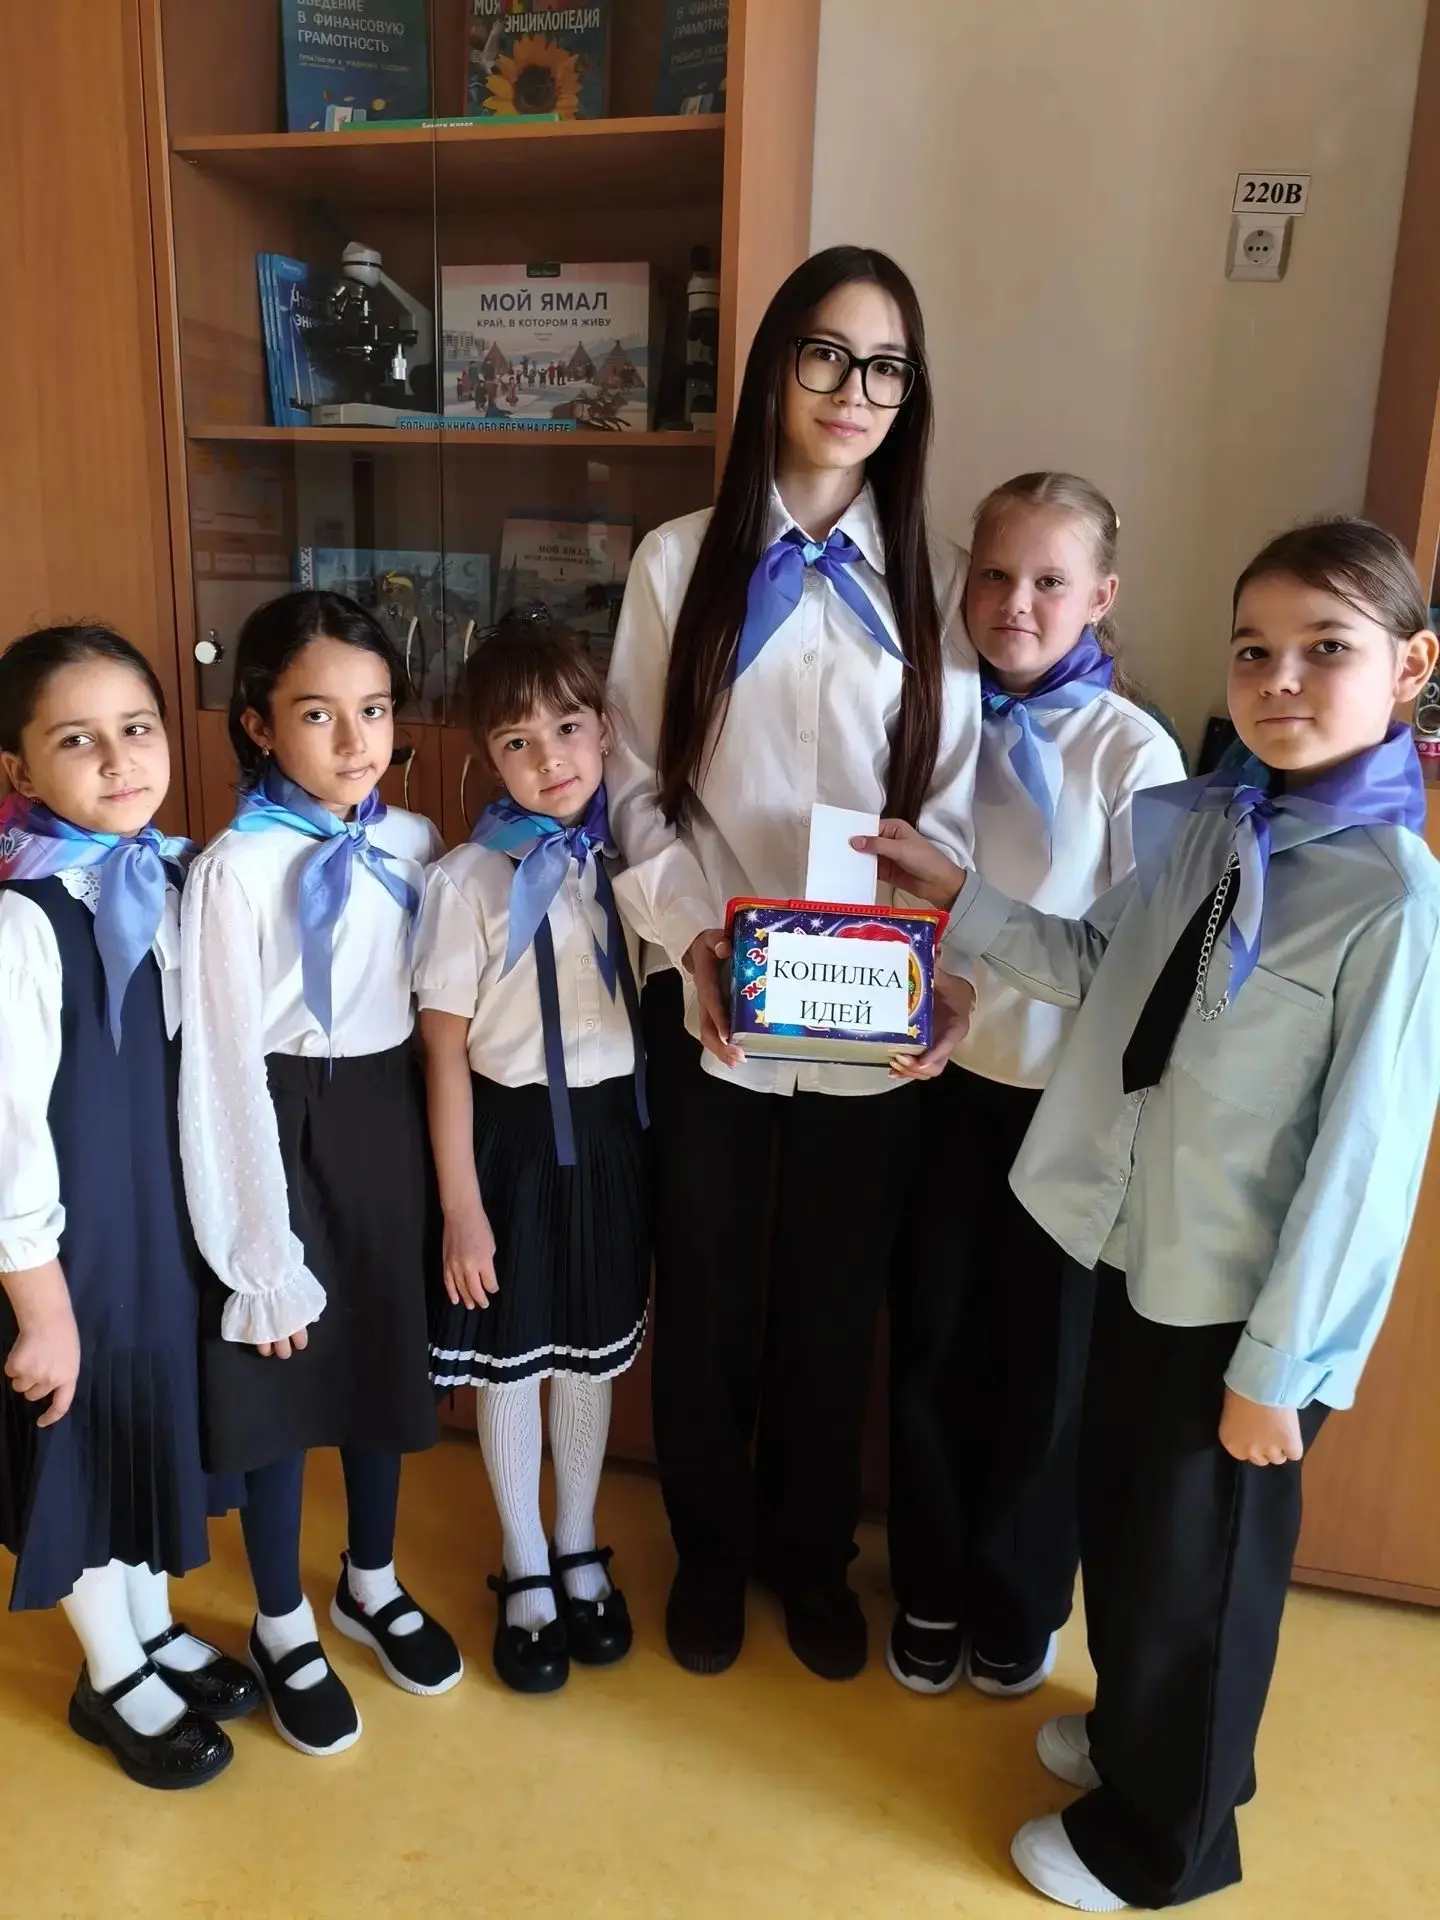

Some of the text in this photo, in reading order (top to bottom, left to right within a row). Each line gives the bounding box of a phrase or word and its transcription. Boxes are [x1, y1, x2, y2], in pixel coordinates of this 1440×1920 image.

[296, 10, 405, 36] В ФИНАНСОВУЮ
[504, 8, 600, 34] ЭНЦИКЛОПЕДИЯ
[297, 29, 390, 53] ГРАМОТНОСТЬ
[1242, 181, 1303, 204] 220В
[480, 289, 608, 312] МОЙ ЯМАЛ
[509, 319, 515, 328] В
[518, 318, 568, 327] КОТОРОМ
[571, 318, 578, 327] Я
[581, 318, 612, 327] ЖИВУ
[448, 421, 475, 431] КНИГА
[527, 423, 539, 432] НА
[773, 959, 904, 989] КОПИЛКА
[799, 1000, 873, 1026] ИДЕЙ
